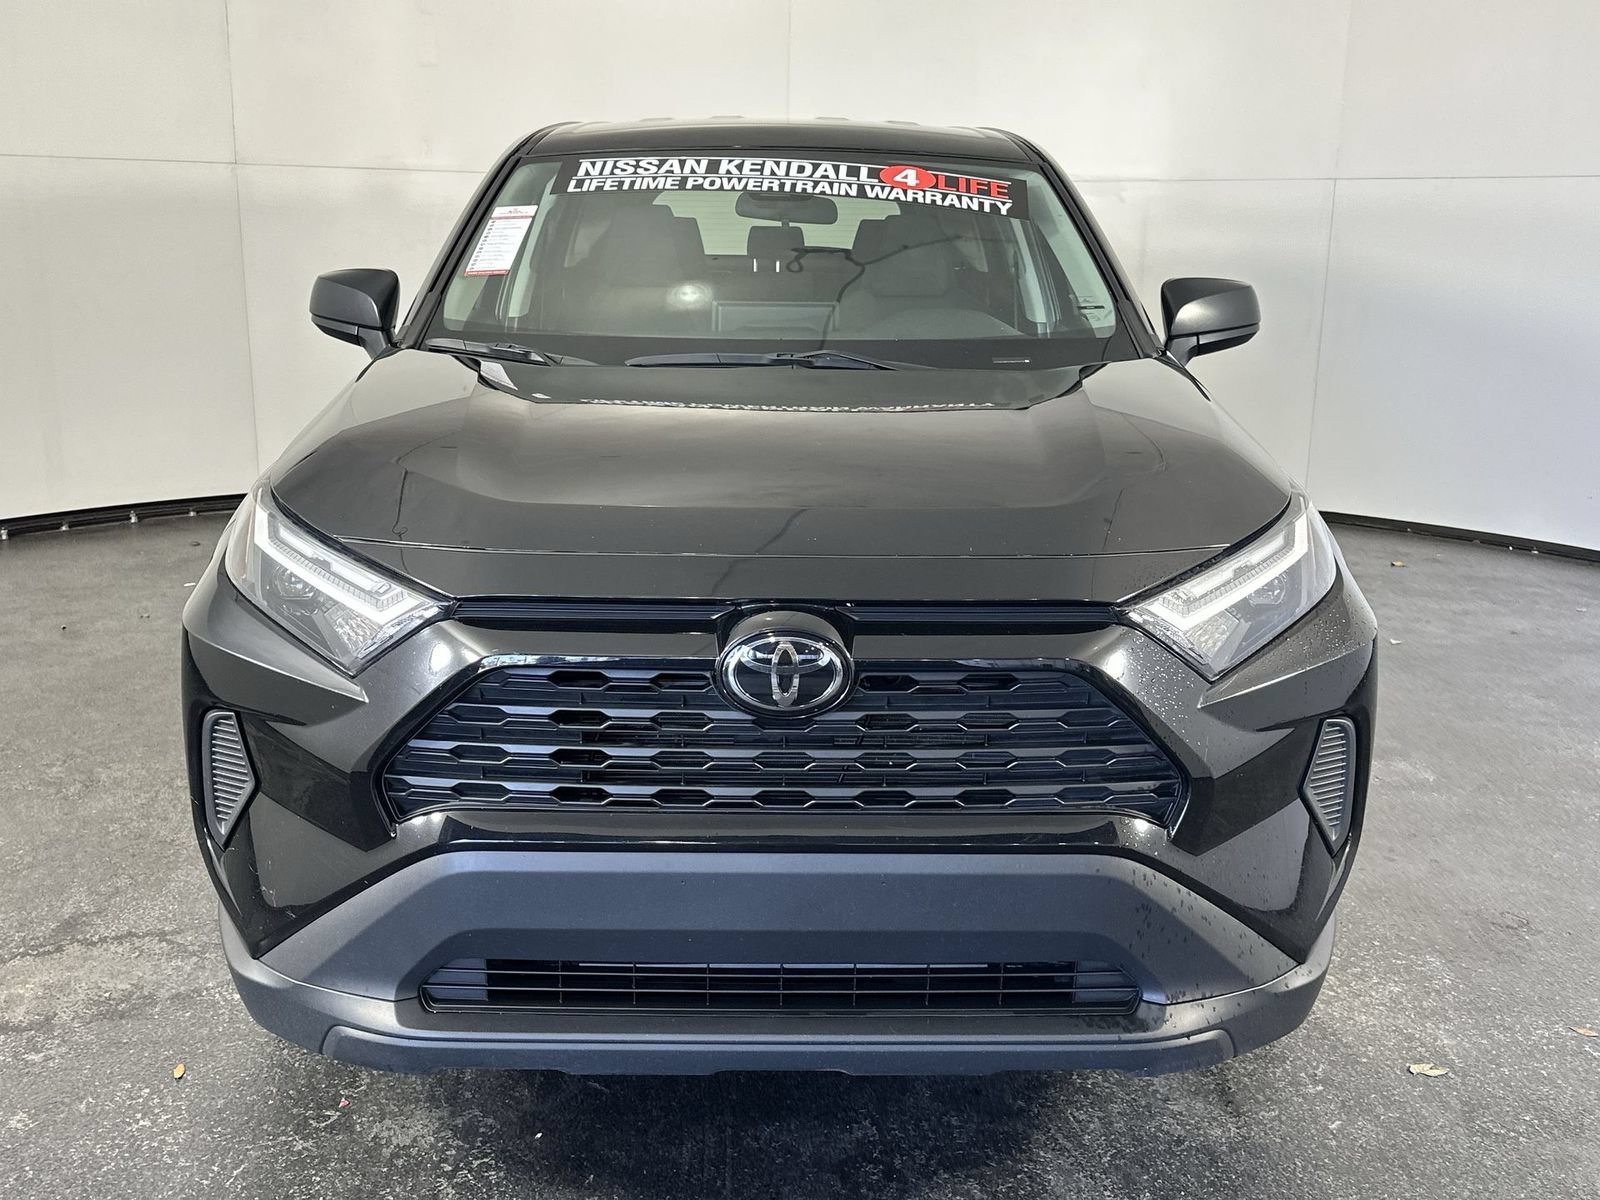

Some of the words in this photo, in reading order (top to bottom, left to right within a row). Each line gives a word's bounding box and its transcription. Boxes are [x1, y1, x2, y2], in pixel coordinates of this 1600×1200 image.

[567, 177, 680, 192] LIFETIME
[686, 177, 859, 197] POWERTRAIN
[865, 185, 1012, 215] WARRANTY
[577, 159, 708, 176] NISSAN
[718, 159, 877, 182] KENDALL
[893, 168, 919, 186] 4
[938, 174, 1010, 199] LIFE
